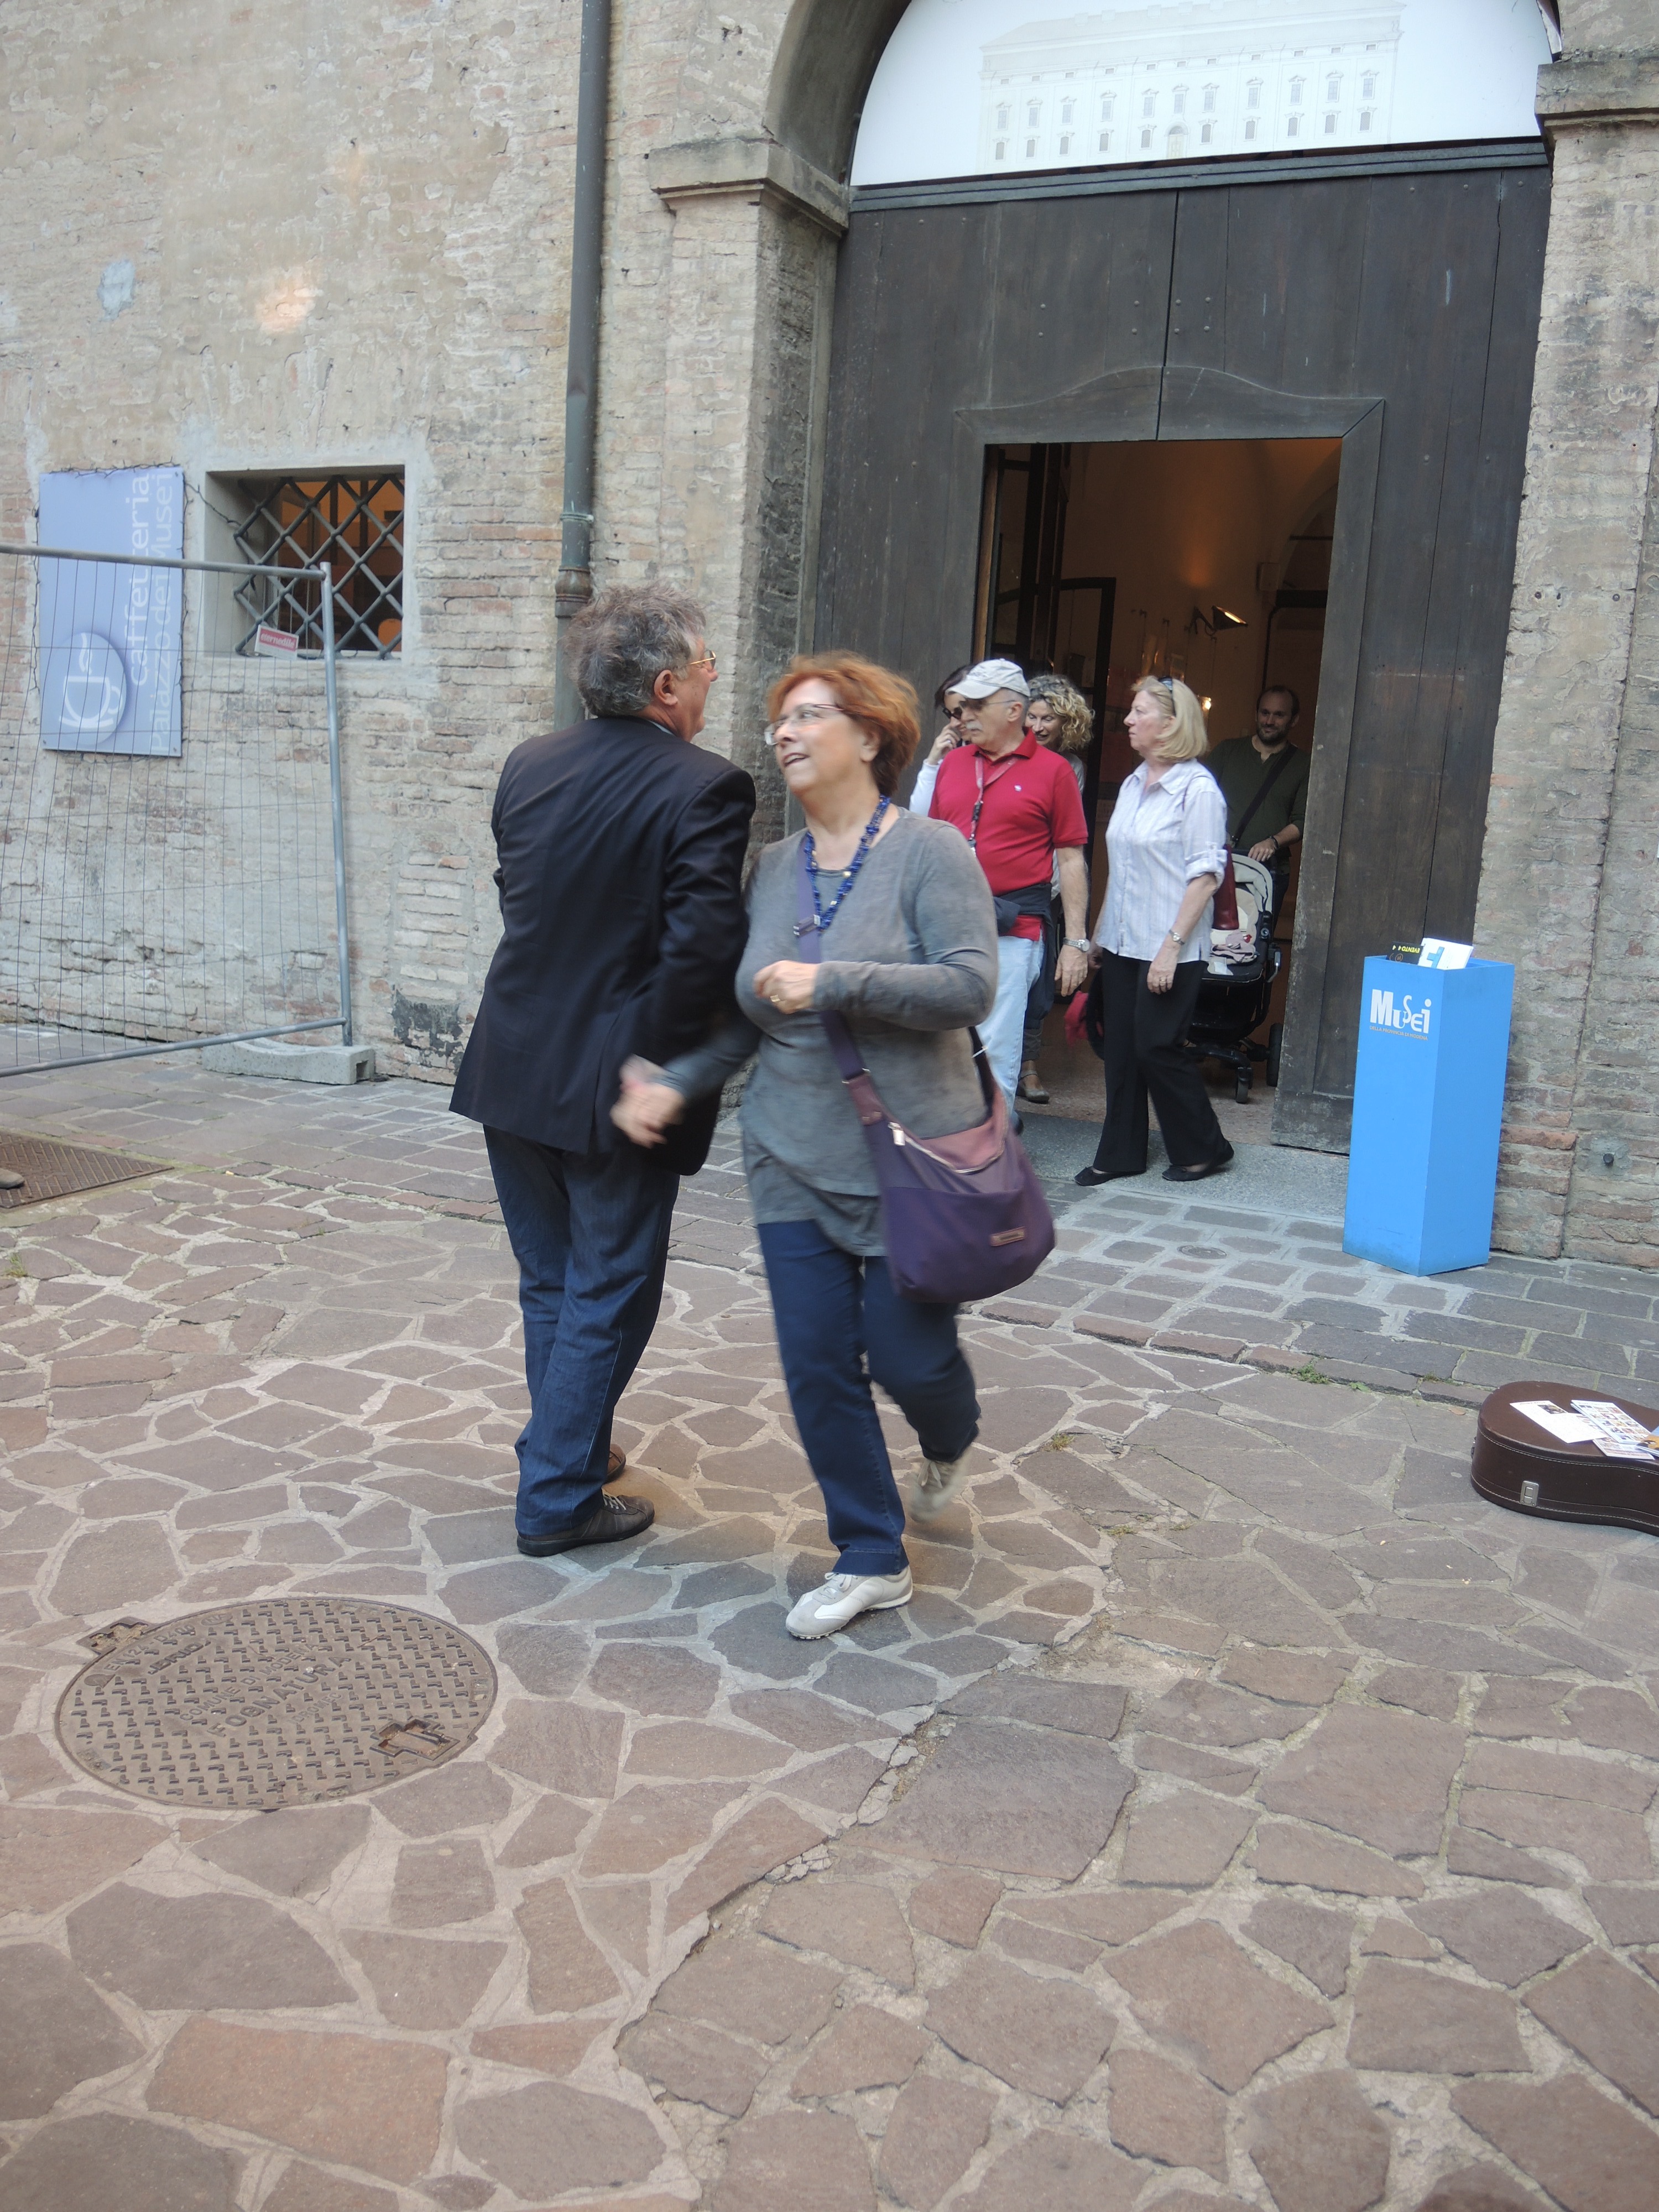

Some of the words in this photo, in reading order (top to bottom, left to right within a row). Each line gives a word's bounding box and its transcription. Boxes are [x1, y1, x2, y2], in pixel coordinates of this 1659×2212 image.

[150, 573, 171, 625] dei
[149, 631, 171, 752] Palazzo
[1383, 1027, 1404, 1036] PROVINCIA
[180, 1687, 241, 1720] COMUNE
[241, 1676, 261, 1686] DI
[259, 1643, 319, 1675] MODENA
[207, 1657, 352, 1737] FOGNATURA
